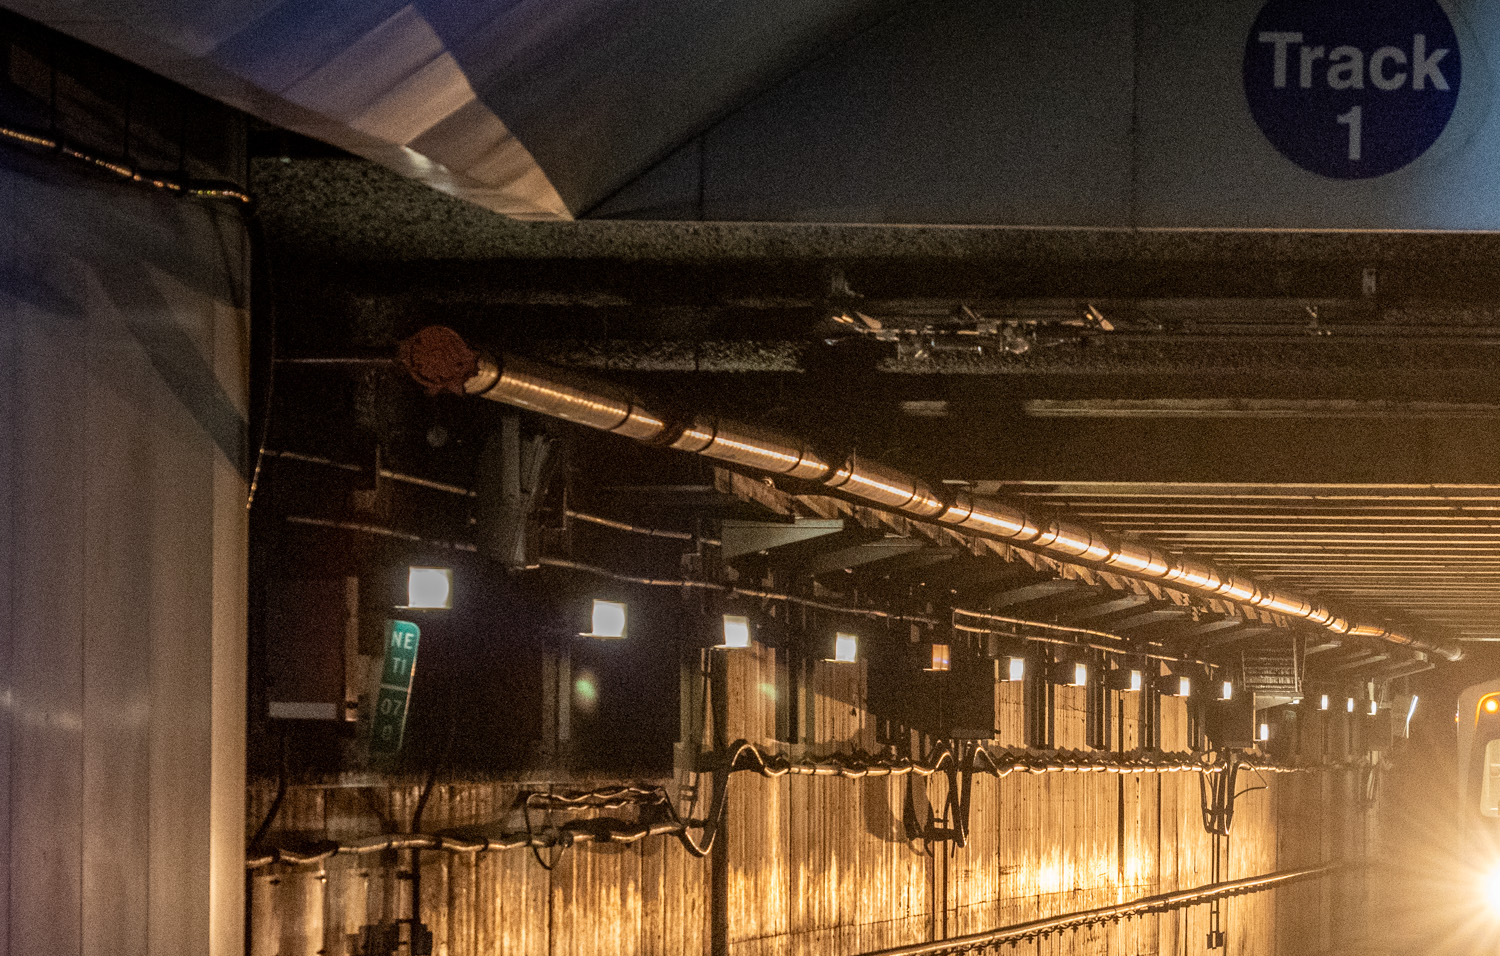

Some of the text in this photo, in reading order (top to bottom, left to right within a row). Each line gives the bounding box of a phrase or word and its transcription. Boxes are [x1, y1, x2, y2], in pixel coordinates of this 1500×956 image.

[1258, 31, 1450, 91] Track
[1336, 105, 1362, 160] 1
[391, 630, 415, 650] NE
[380, 697, 402, 716] 07
